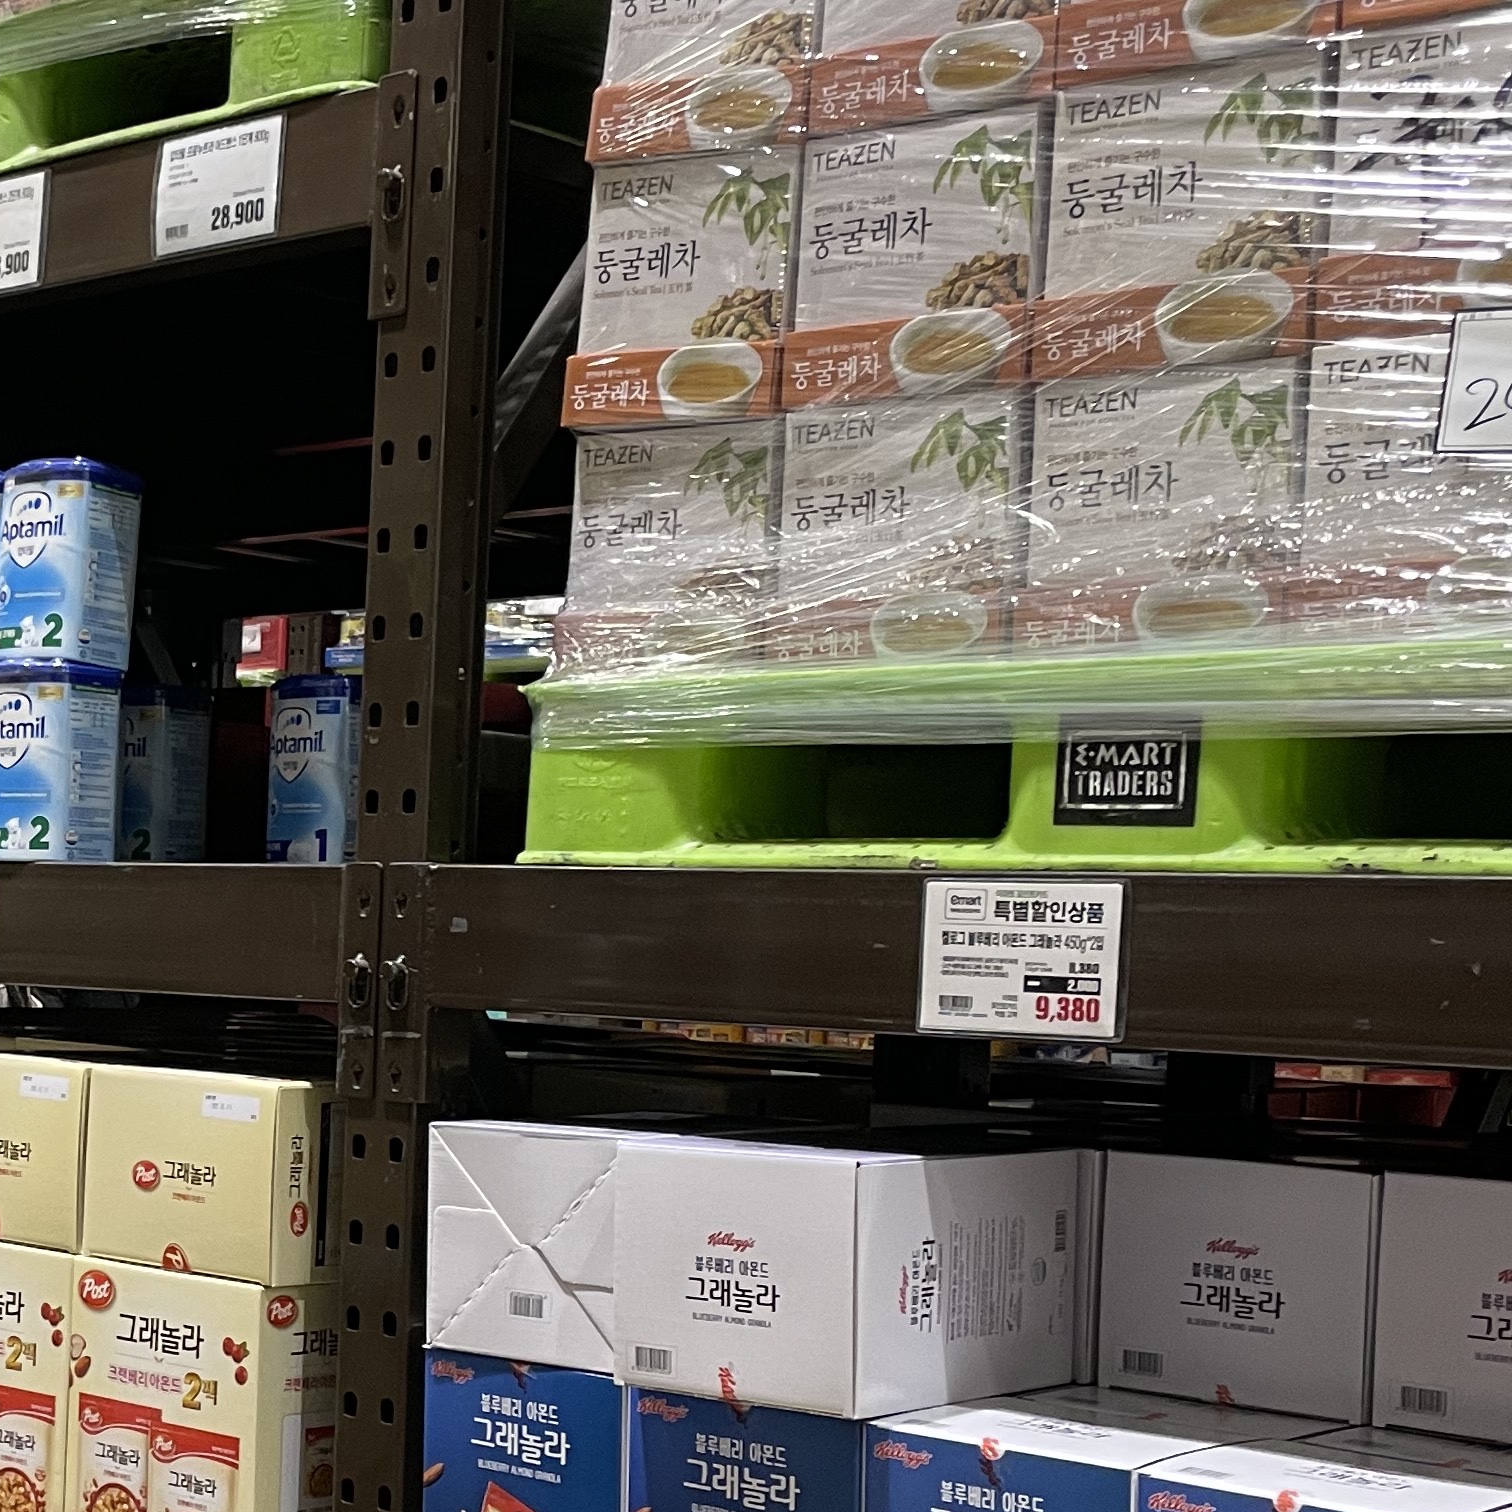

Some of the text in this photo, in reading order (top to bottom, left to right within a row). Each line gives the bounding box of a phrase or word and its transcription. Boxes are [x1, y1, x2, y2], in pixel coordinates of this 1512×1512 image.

[1067, 18, 1174, 70] 둥굴레차
[1351, 32, 1465, 74] TEAZEN
[819, 66, 913, 116] 둥굴레차
[1066, 89, 1162, 127] TEAZEN
[813, 140, 897, 173] TEAZEN
[601, 175, 674, 201] TEAZEN
[1061, 160, 1204, 220] 둥굴레차
[211, 197, 265, 232] 28,900
[809, 207, 933, 260] 둥굴레차
[593, 240, 701, 284] 둥굴레차
[1041, 320, 1148, 362] 둥굴레차
[790, 352, 883, 391] 둥굴레차
[570, 376, 652, 411] 둥굴레차
[1045, 388, 1139, 420] TEAZEN
[795, 417, 875, 446] TEAZEN
[584, 444, 655, 469] TEAZEN
[1047, 461, 1181, 513] 둥굴레차
[790, 485, 913, 532] 둥굴레차
[1, 514, 65, 543] Aptamil
[44, 612, 64, 648] 2
[1074, 770, 1175, 798] TRADERS
[29, 816, 50, 851] 2
[314, 828, 328, 863] 1
[994, 901, 1105, 924] 특별할인상품
[1035, 995, 1100, 1023] 9,380
[134, 1165, 158, 1183] Post
[163, 1161, 217, 1187] 그래놀라
[695, 1255, 770, 1280] 블루베리 아몬드
[1191, 1261, 1275, 1286] 블루베리 아몬드
[80, 1277, 111, 1300] Post
[684, 1276, 782, 1316] 그래놀라
[1180, 1282, 1286, 1320] 그래놀라
[116, 1313, 204, 1359] 그래놀라
[481, 1393, 559, 1426] 블루베리 아몬드
[470, 1417, 571, 1466] 그래놀라
[695, 1432, 787, 1468] 블루베리 아몬드
[683, 1457, 801, 1512] 그래놀라
[940, 1480, 996, 1512] 블루베리
